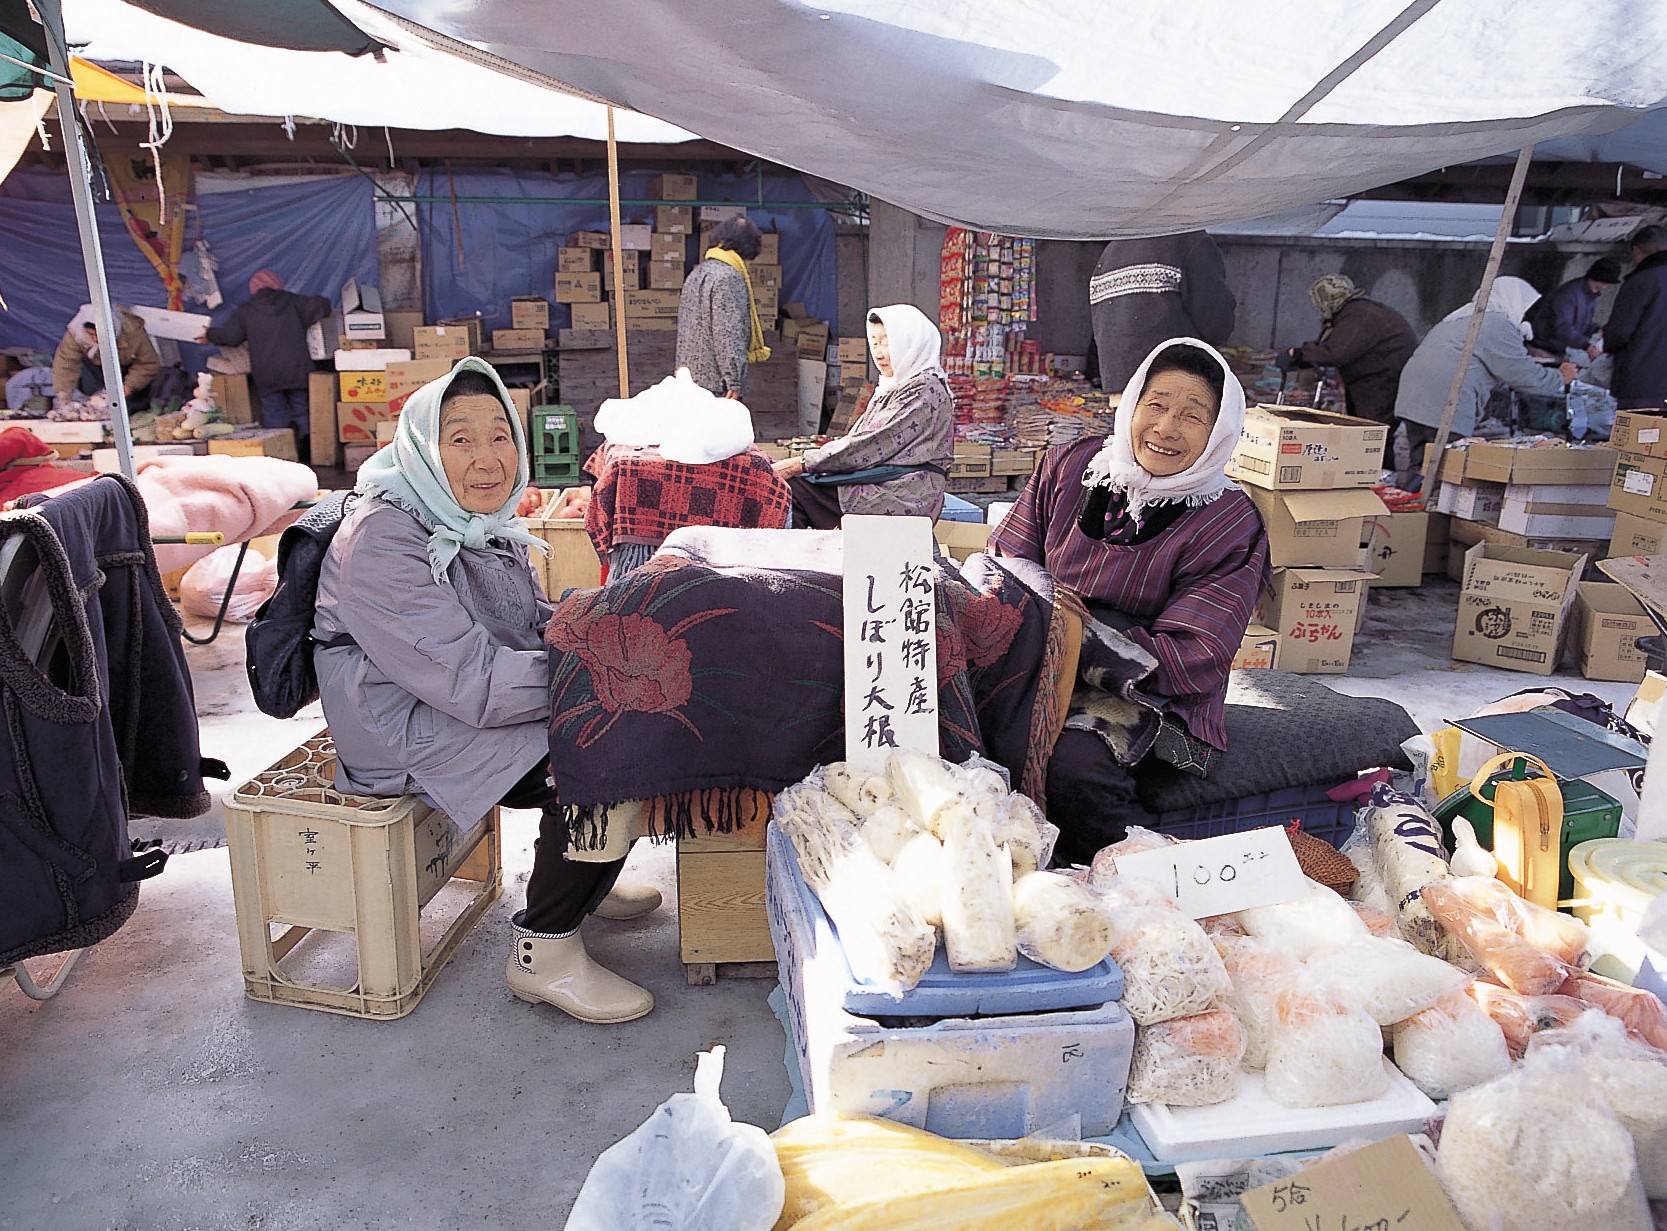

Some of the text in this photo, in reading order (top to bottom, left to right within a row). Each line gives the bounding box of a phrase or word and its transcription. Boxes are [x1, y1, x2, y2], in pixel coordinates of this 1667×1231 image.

[860, 575, 900, 749] しぼり大根
[899, 562, 935, 715] 松館特産
[1305, 609, 1332, 619] 10本入
